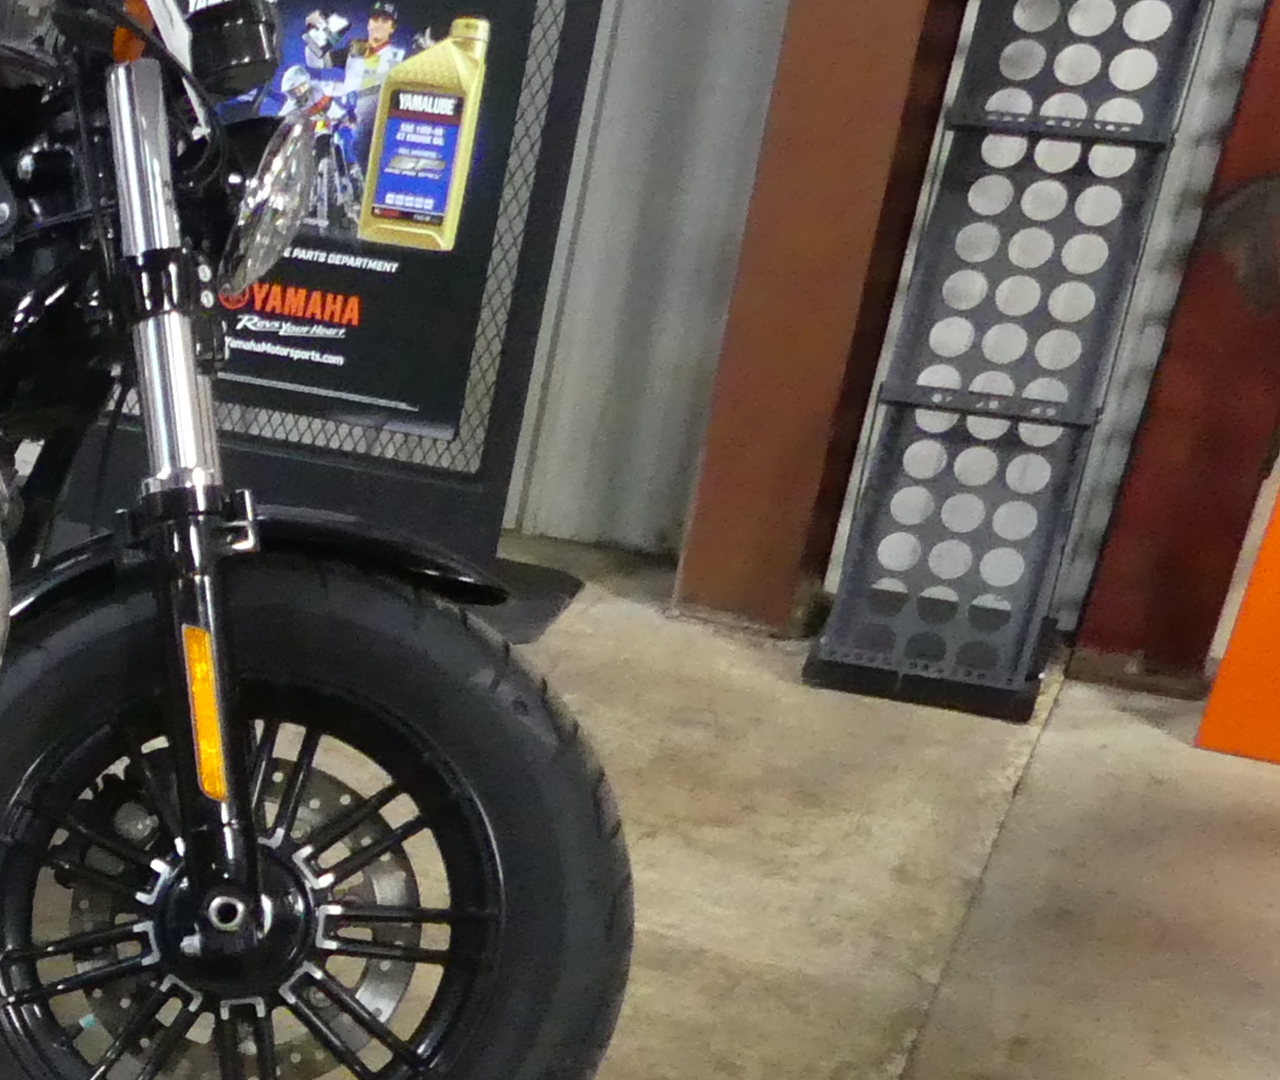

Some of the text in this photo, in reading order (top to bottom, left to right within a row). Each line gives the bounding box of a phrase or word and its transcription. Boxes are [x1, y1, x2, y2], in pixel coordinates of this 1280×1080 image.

[399, 93, 455, 115] YAMALUBE
[292, 247, 327, 263] PARTS
[326, 254, 399, 273] DEPARTMENT
[252, 281, 362, 327] YAMAHA
[225, 336, 345, 366] YamahaMotorsports.com
